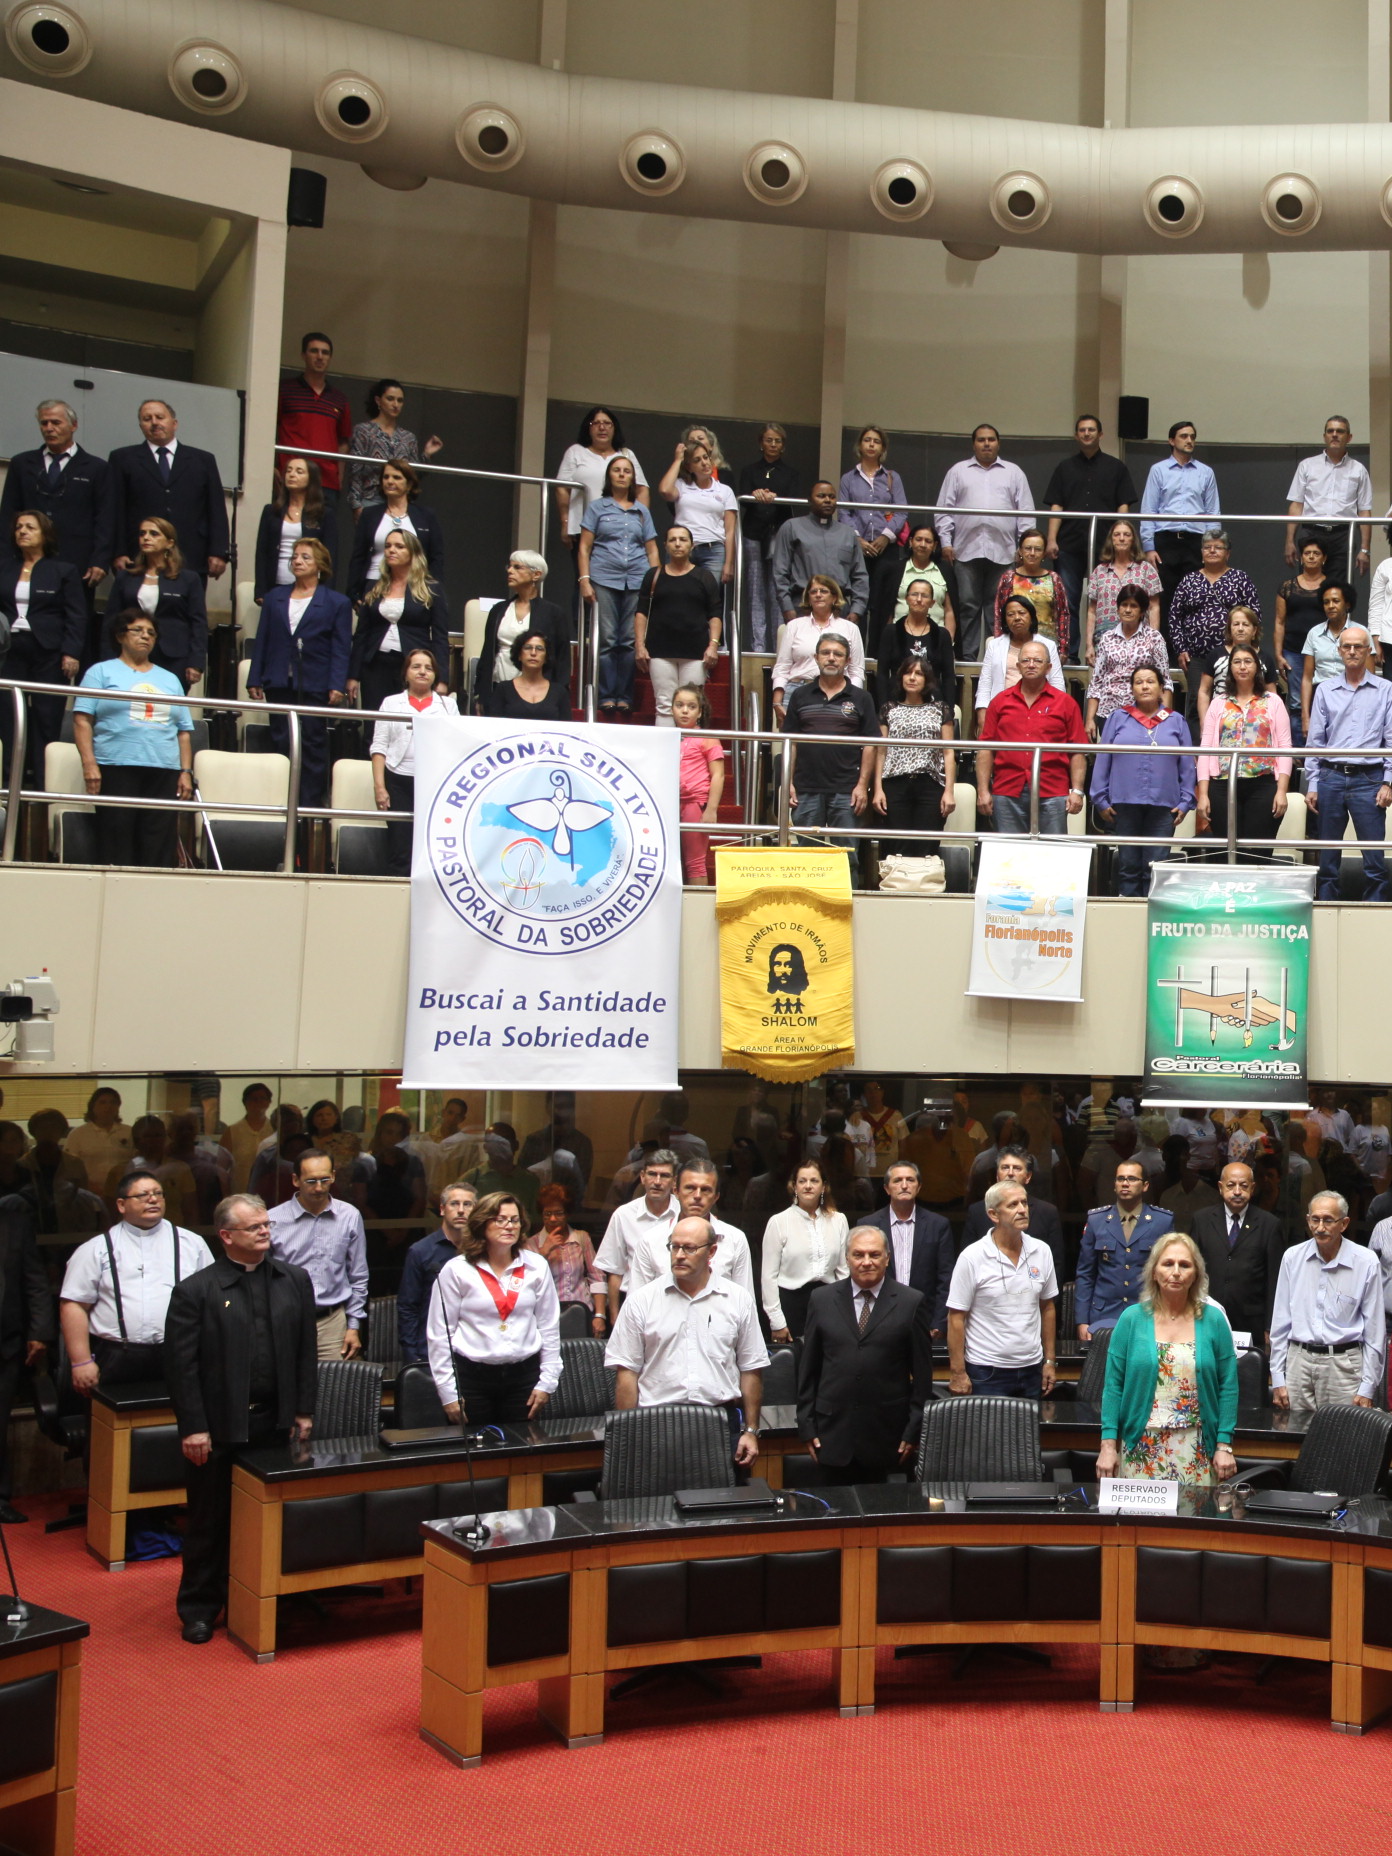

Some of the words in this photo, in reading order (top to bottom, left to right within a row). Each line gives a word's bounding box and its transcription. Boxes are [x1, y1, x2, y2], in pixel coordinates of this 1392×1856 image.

[446, 739, 571, 810] REGIONAL
[579, 750, 632, 792] SUL
[623, 792, 650, 818] IV
[436, 836, 505, 937] PASTORAL
[517, 923, 549, 947] DA
[560, 845, 659, 947] SOBRIEDADE
[1208, 881, 1221, 893] A
[1225, 881, 1257, 893] PAZ
[572, 894, 597, 909] ISSO,
[595, 886, 604, 895] E
[1225, 897, 1236, 913] É
[986, 913, 1020, 924] Forania
[985, 924, 1073, 943] Florianópolis
[1151, 922, 1206, 937] FRUTO
[1211, 923, 1233, 938] DA
[1237, 924, 1309, 943] JUSTIÇA
[745, 921, 787, 964] MOVIMENTO
[789, 922, 804, 933] DE
[804, 928, 828, 964] IRMÃOS
[1038, 944, 1072, 958] Norte
[419, 987, 504, 1011] Buscai
[512, 993, 527, 1011] a
[537, 990, 667, 1014] Santidade
[761, 1016, 818, 1027] SHALOM
[433, 1024, 492, 1052] pela
[502, 1025, 650, 1050] Sobriedade
[774, 1036, 796, 1044] ÁREA
[740, 1045, 774, 1053] GRANDE
[775, 1044, 839, 1053] FLORIANÓPOLIS
[1151, 1057, 1300, 1075] Carcerária
[1242, 1073, 1301, 1081] Florianópolis
[1112, 1484, 1167, 1494] RESERVADO
[1111, 1495, 1166, 1504] DEPUTADOS
